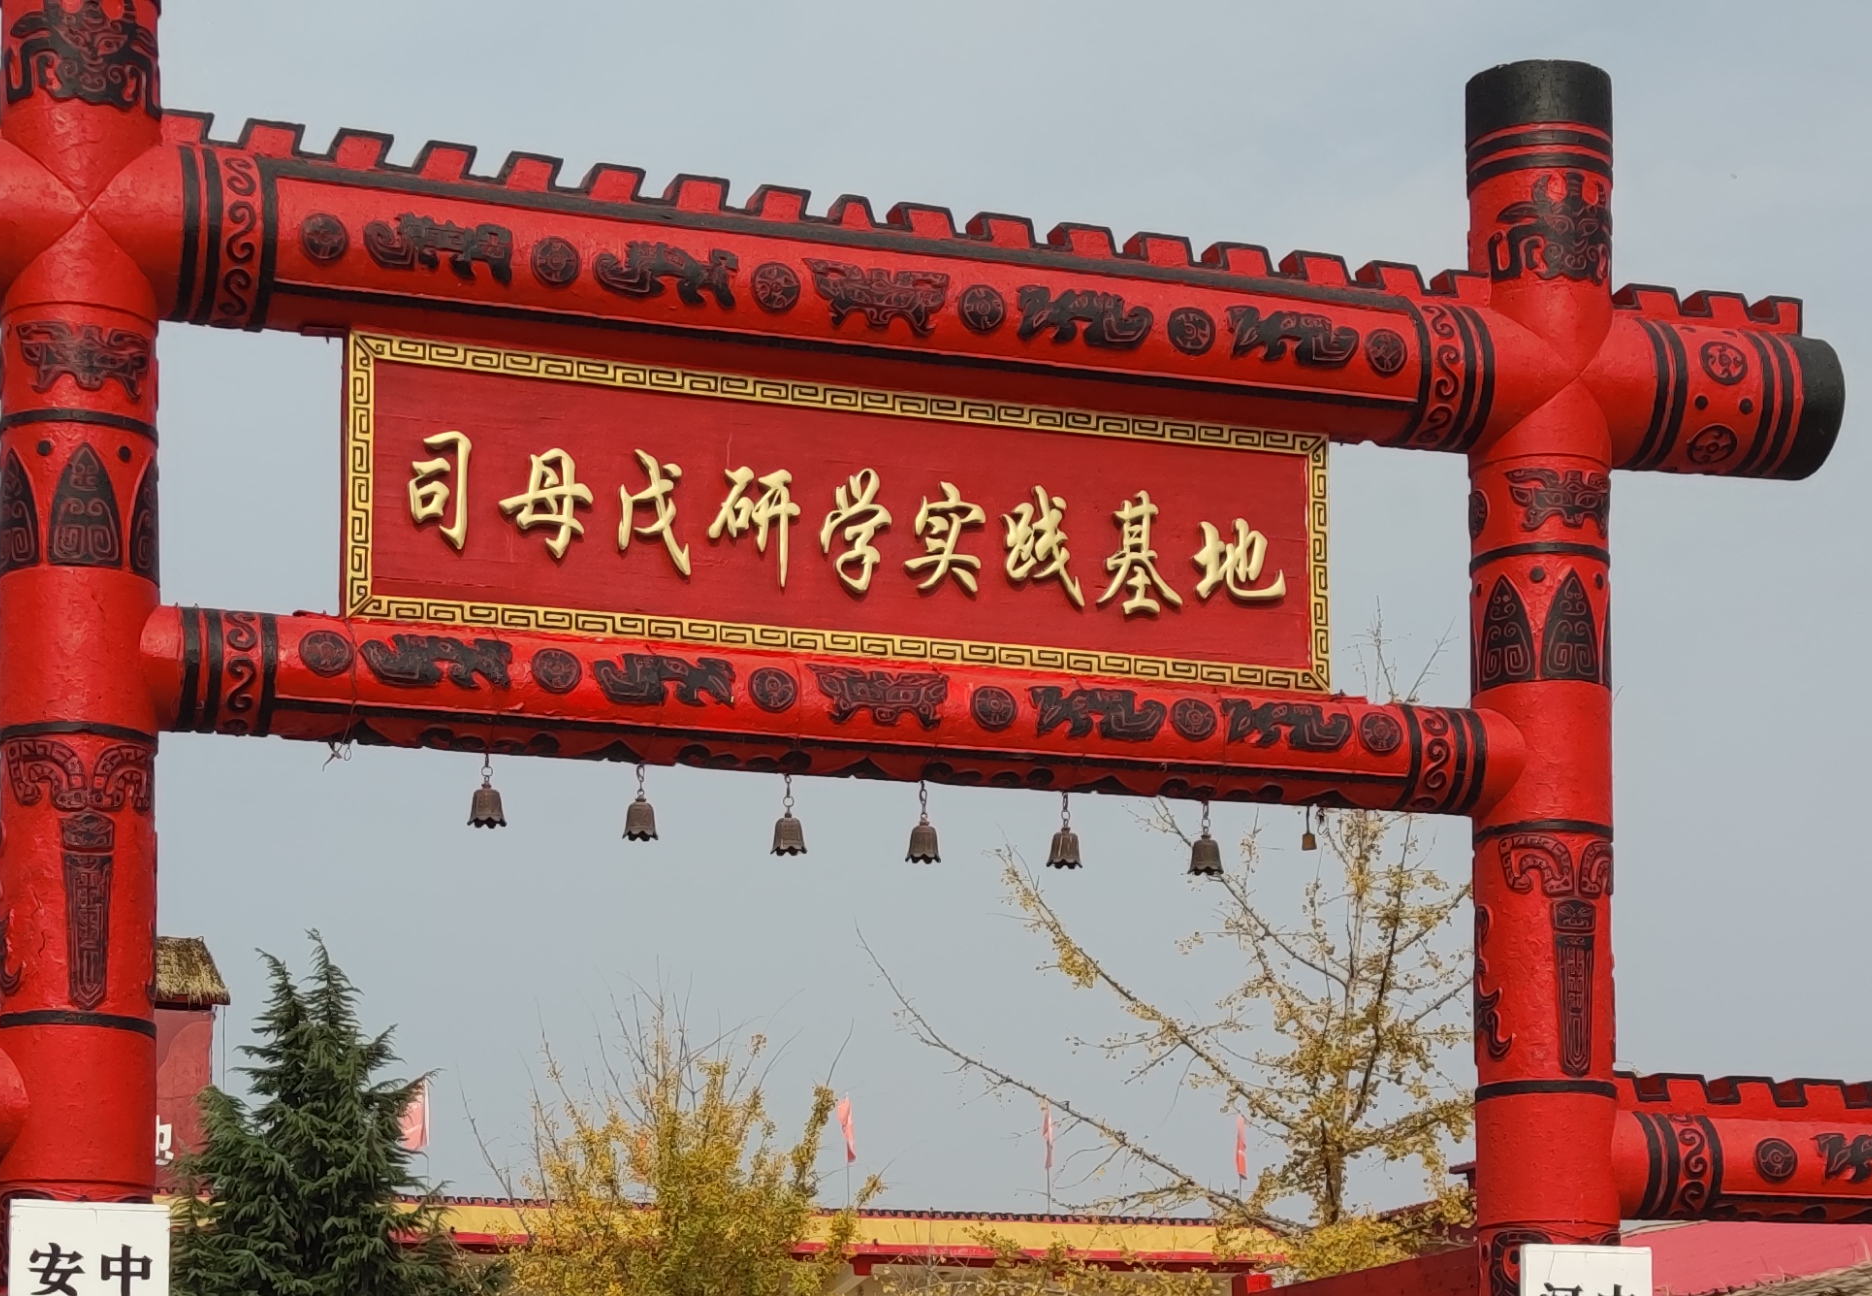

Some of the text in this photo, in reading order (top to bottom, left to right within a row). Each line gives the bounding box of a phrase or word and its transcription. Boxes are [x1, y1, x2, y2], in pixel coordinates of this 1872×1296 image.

[407, 430, 1287, 615] 司母戊研学实践基地
